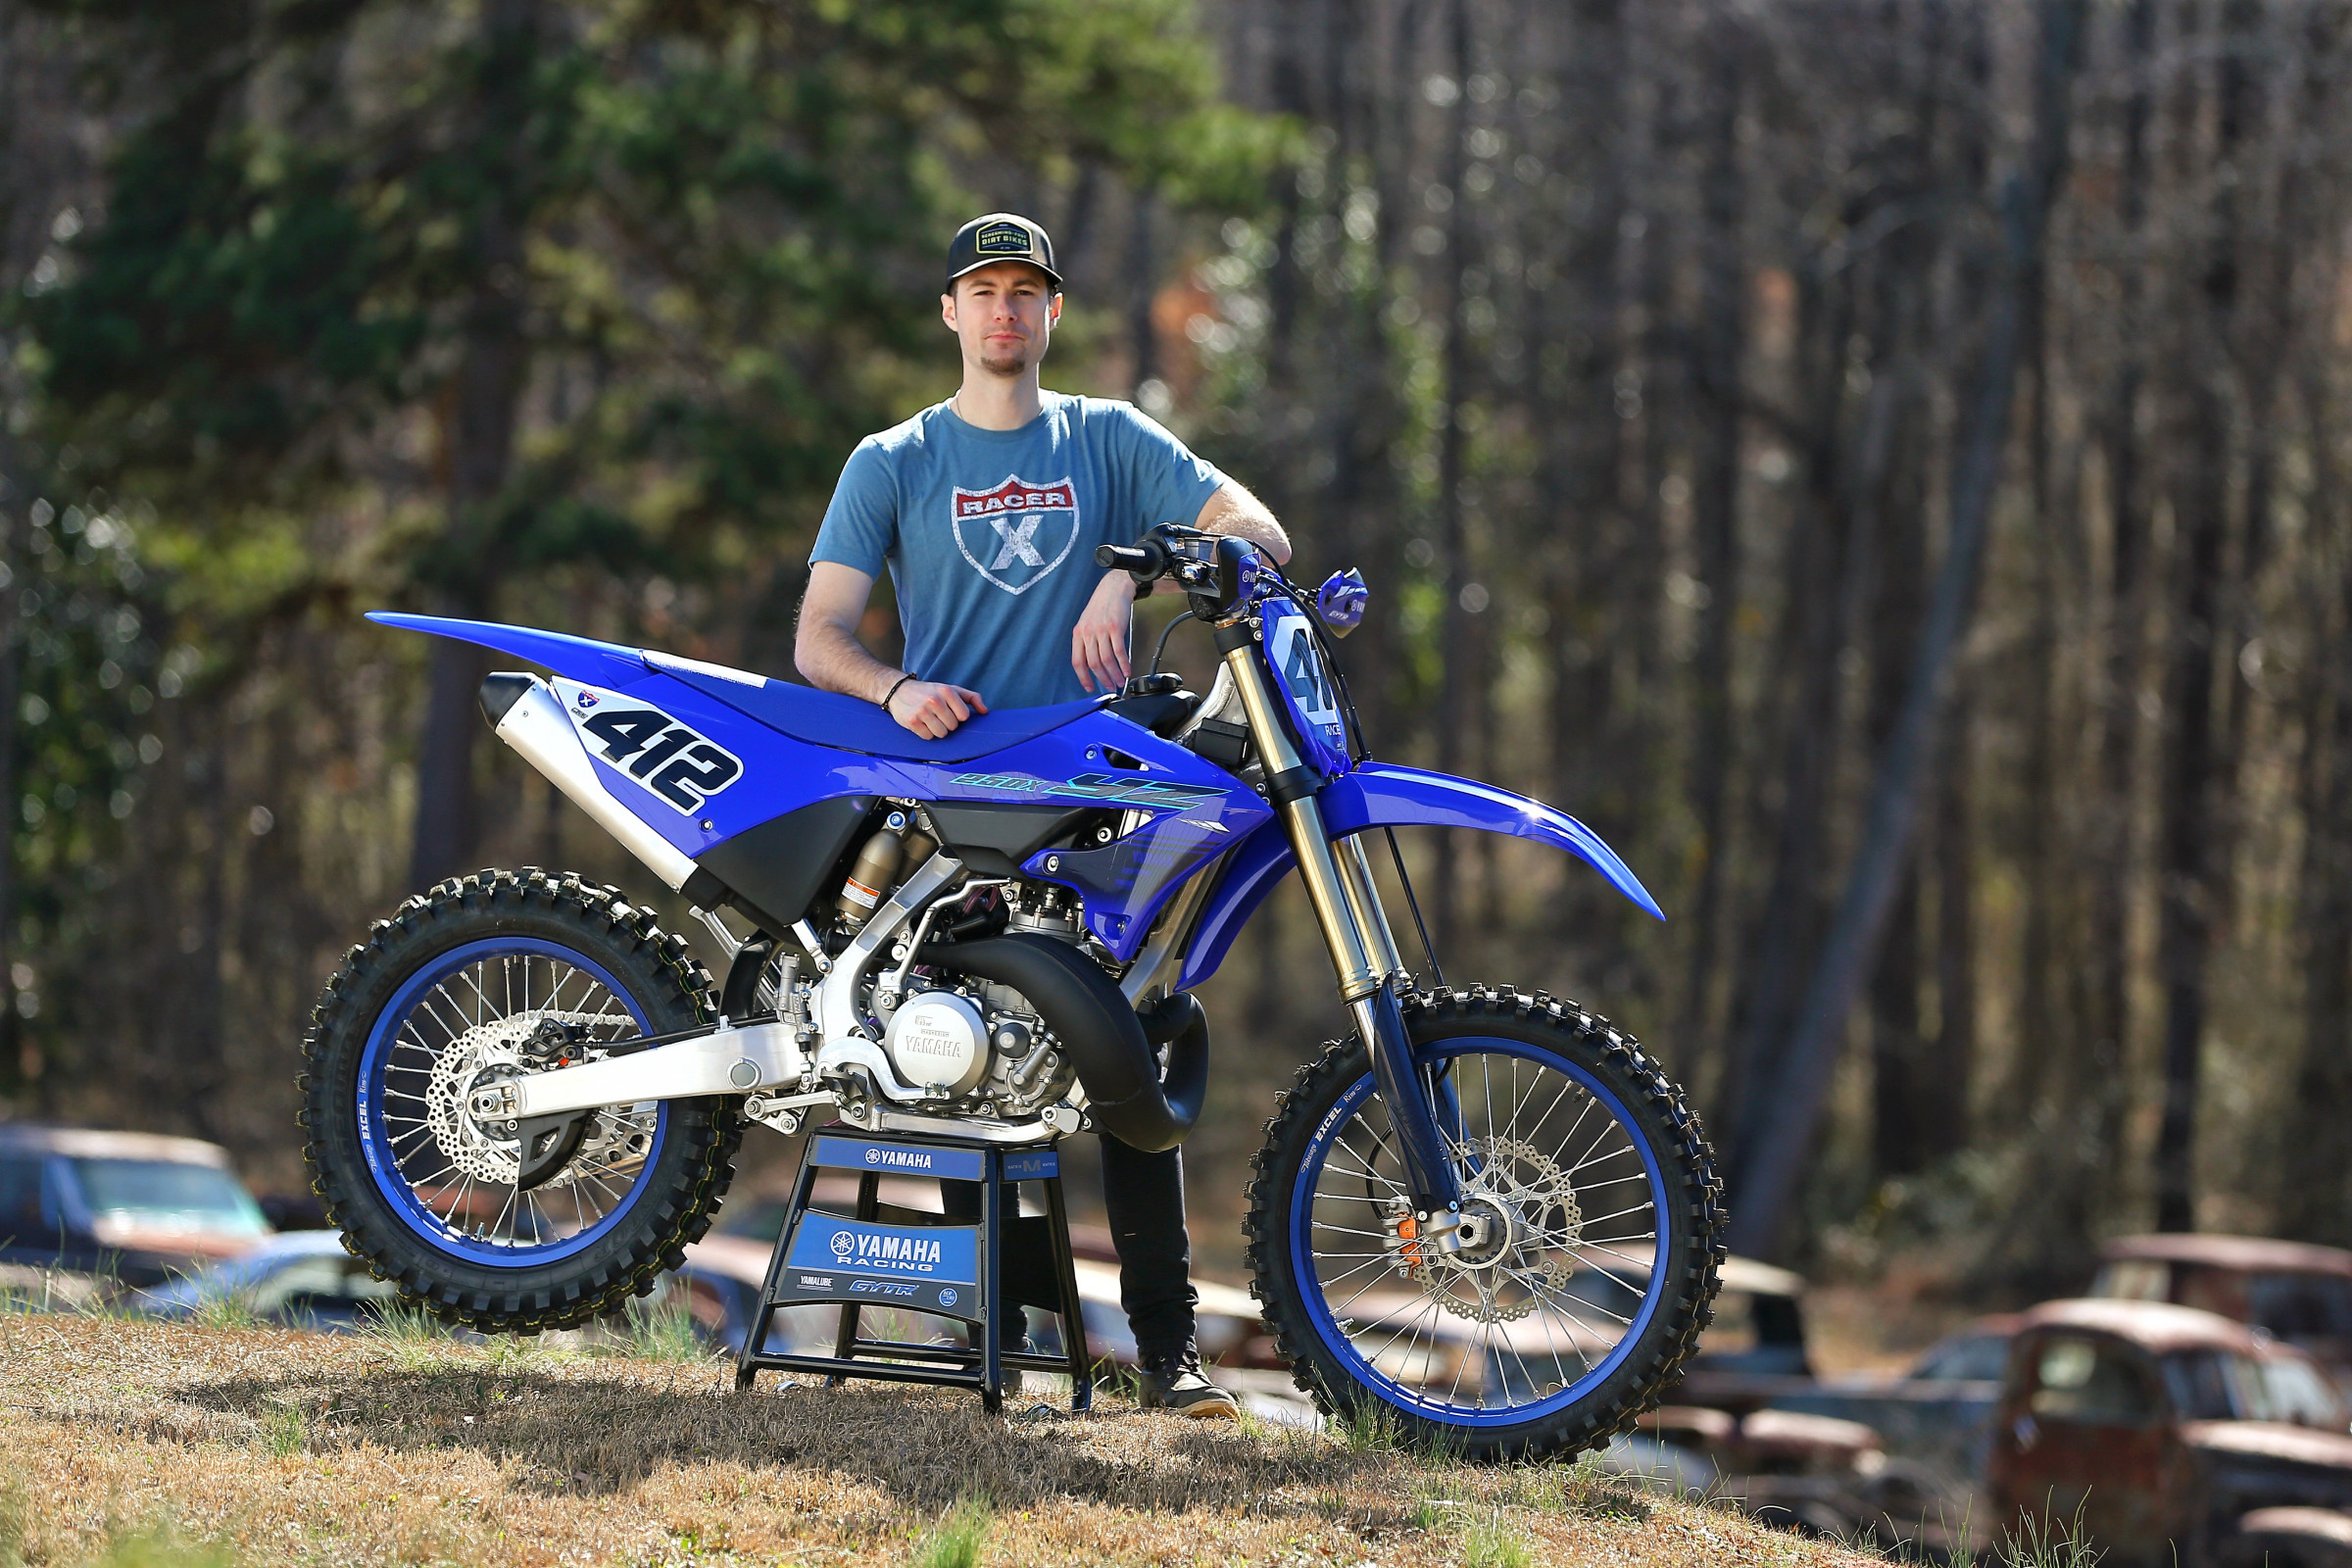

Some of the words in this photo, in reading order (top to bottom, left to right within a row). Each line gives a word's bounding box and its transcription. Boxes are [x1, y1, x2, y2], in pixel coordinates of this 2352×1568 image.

[982, 236, 1001, 245] DIRT
[1003, 235, 1027, 246] BIKES
[962, 492, 1065, 514] RACER
[989, 514, 1046, 570] X
[582, 710, 739, 811] 412
[949, 773, 1048, 792] 250X
[906, 1035, 961, 1058] YAMAHA
[359, 1100, 370, 1140] EXCEL
[1315, 1107, 1343, 1142] EXCEL
[881, 1151, 932, 1169] YAMAHA
[858, 1234, 941, 1263] YAMAHA
[837, 1255, 933, 1272] RACING
[800, 1275, 833, 1287] YAMALUBE
[849, 1279, 917, 1297] GYTR
